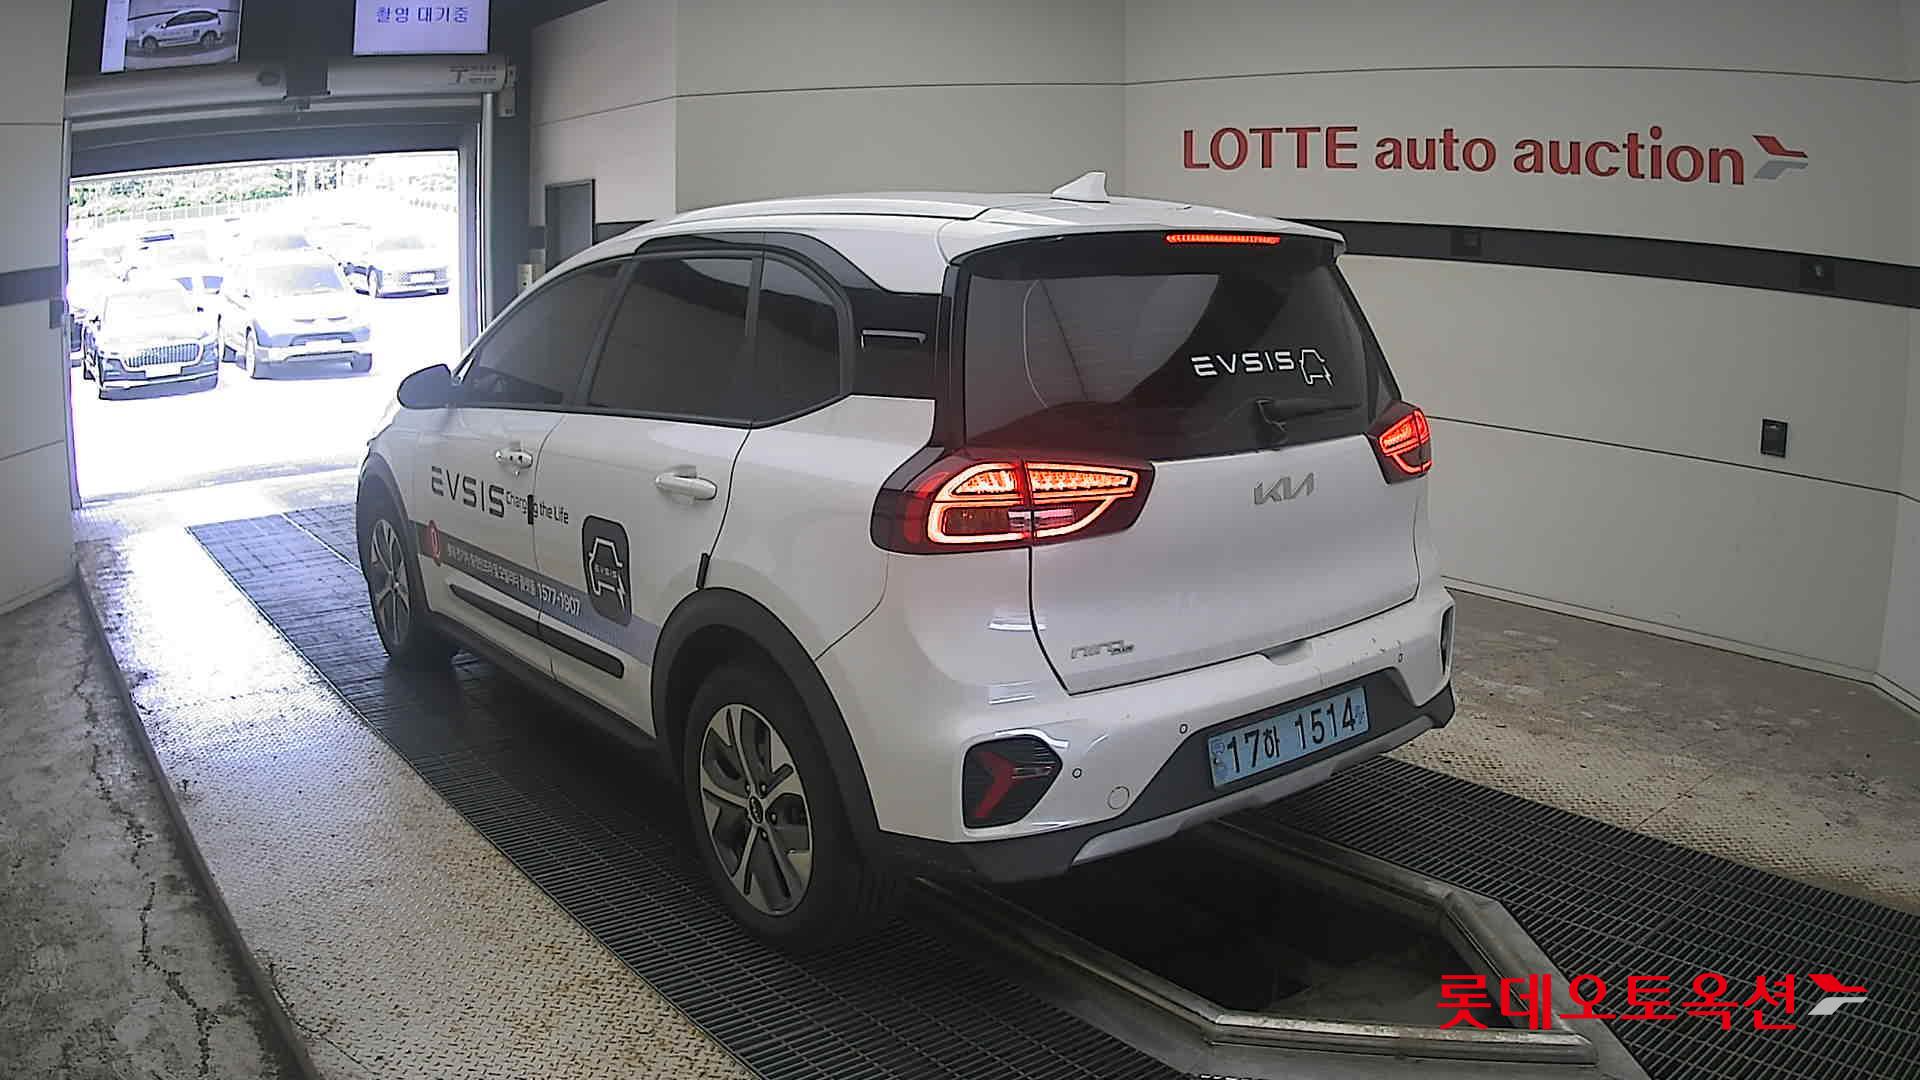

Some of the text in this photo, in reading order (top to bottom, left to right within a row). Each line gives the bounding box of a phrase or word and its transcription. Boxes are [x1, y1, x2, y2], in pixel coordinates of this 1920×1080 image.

[417, 7, 469, 24] 대기중
[1183, 126, 1744, 185] LOTTE auto auction
[1191, 351, 1295, 377] EVSIS
[431, 465, 505, 518] EVSIS
[506, 490, 538, 518] Chargg
[1226, 725, 1280, 773] 17하
[1294, 695, 1356, 750] 1514
